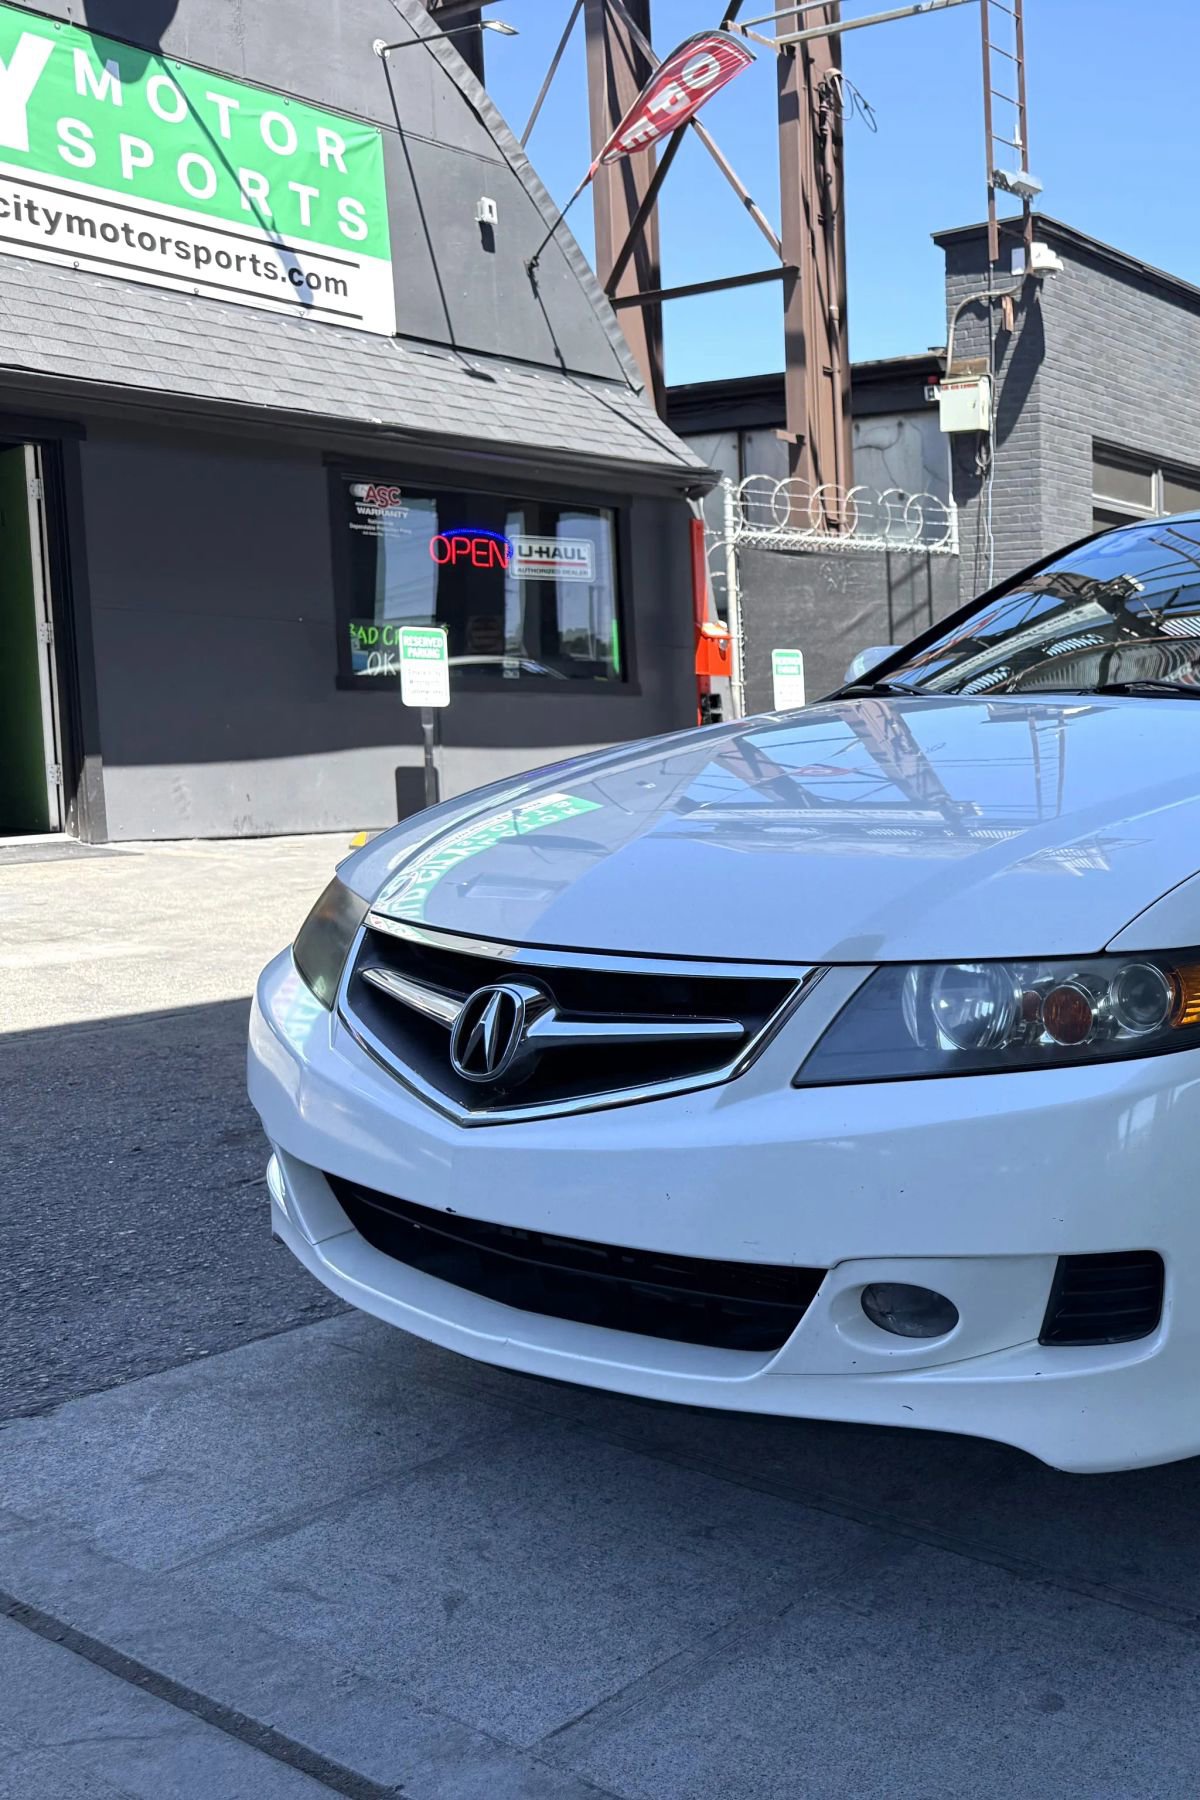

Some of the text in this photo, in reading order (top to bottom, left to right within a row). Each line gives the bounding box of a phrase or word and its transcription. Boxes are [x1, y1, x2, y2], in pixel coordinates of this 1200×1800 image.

[73, 48, 349, 174] MOTOR
[56, 117, 369, 241] SPORTS
[363, 484, 402, 508] ASC
[356, 506, 408, 519] WARRANTY
[429, 535, 510, 569] OPEN
[518, 545, 587, 560] U-HAUL
[517, 567, 561, 575] AUTHORIZED
[403, 635, 443, 648] RESERVED
[407, 647, 441, 659] PARKING
[367, 651, 396, 676] OK
